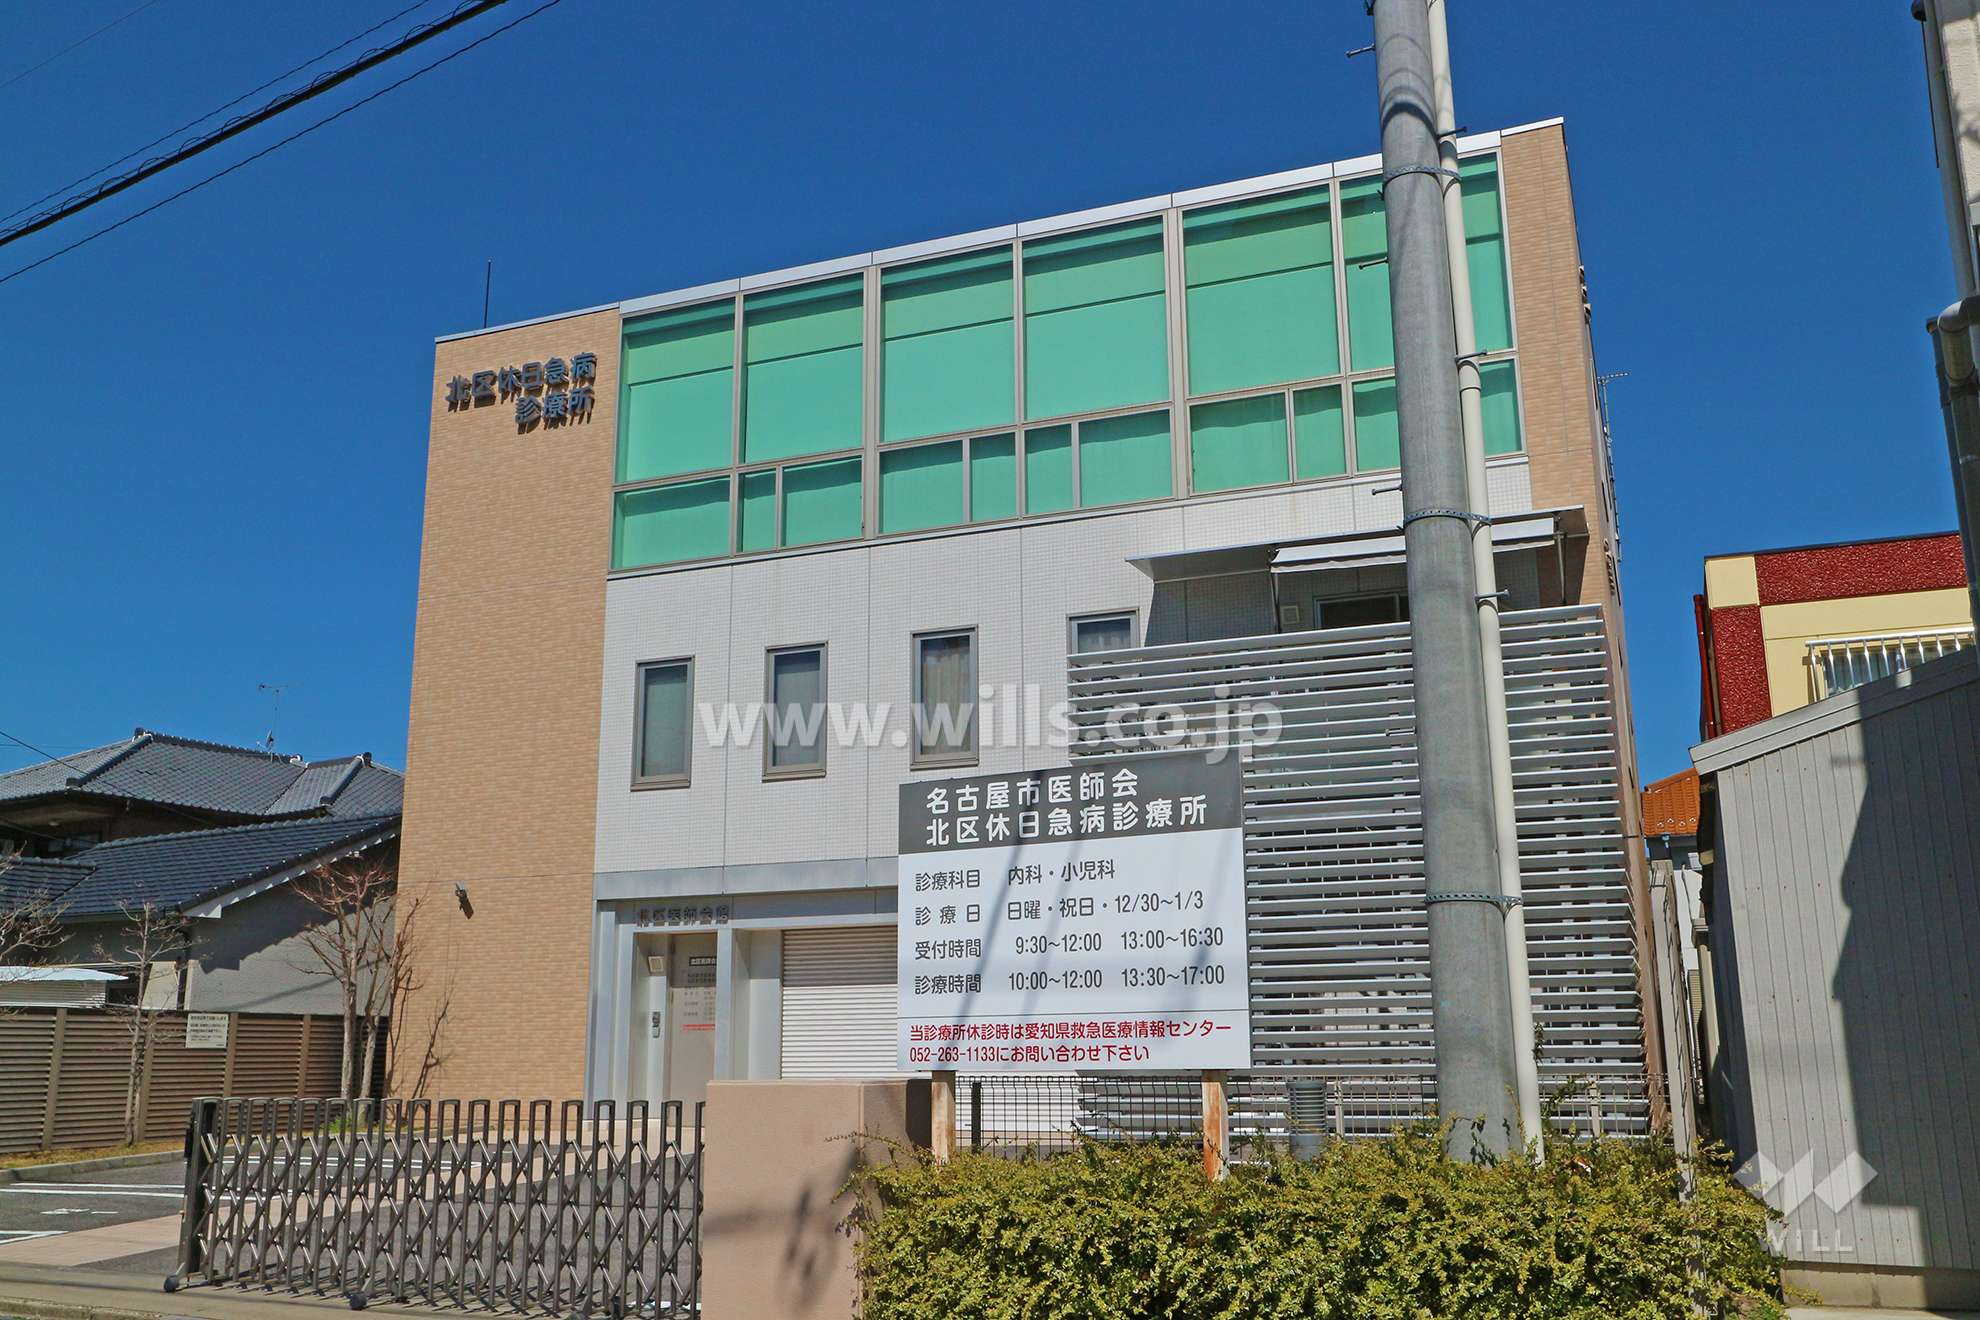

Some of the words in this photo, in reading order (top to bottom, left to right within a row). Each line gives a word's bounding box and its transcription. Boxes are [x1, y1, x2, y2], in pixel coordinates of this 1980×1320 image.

[446, 352, 598, 409] 北区休日急病
[515, 385, 596, 430] 診療所
[926, 767, 1139, 815] 名古屋市医師会
[926, 794, 1208, 847] 北区休日急病診療所
[915, 870, 981, 892] 診療科目
[1008, 859, 1116, 886] 内科・小児科
[915, 939, 982, 961] 受付時間
[914, 974, 982, 996] 診療時間
[909, 1019, 1232, 1041] 当診療所休診時は愛知県救急医療情報センター
[909, 1044, 1151, 1063] 052-263-1133にお問い合わせ下さい
